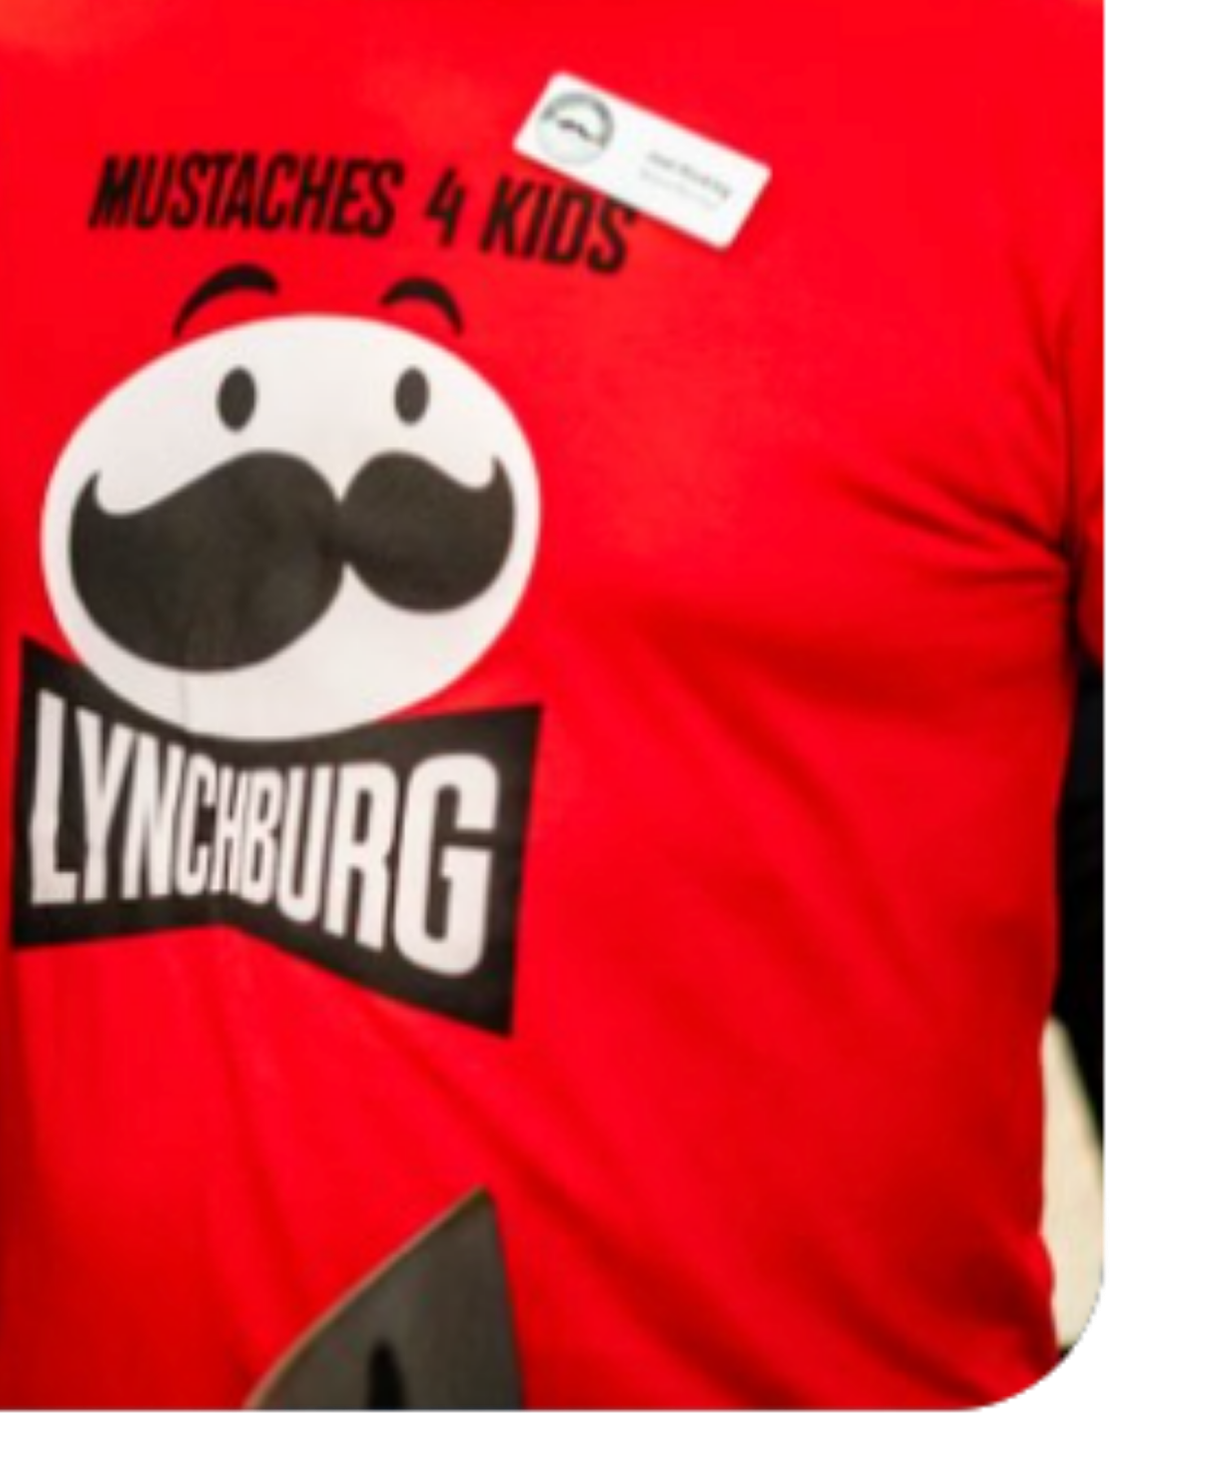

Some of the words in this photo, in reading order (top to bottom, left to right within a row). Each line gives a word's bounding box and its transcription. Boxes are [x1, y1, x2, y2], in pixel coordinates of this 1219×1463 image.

[87, 150, 404, 239] MUSTACHES
[423, 166, 466, 247] 4
[479, 175, 638, 275] KIDS
[30, 688, 499, 979] LYNCHBURG
